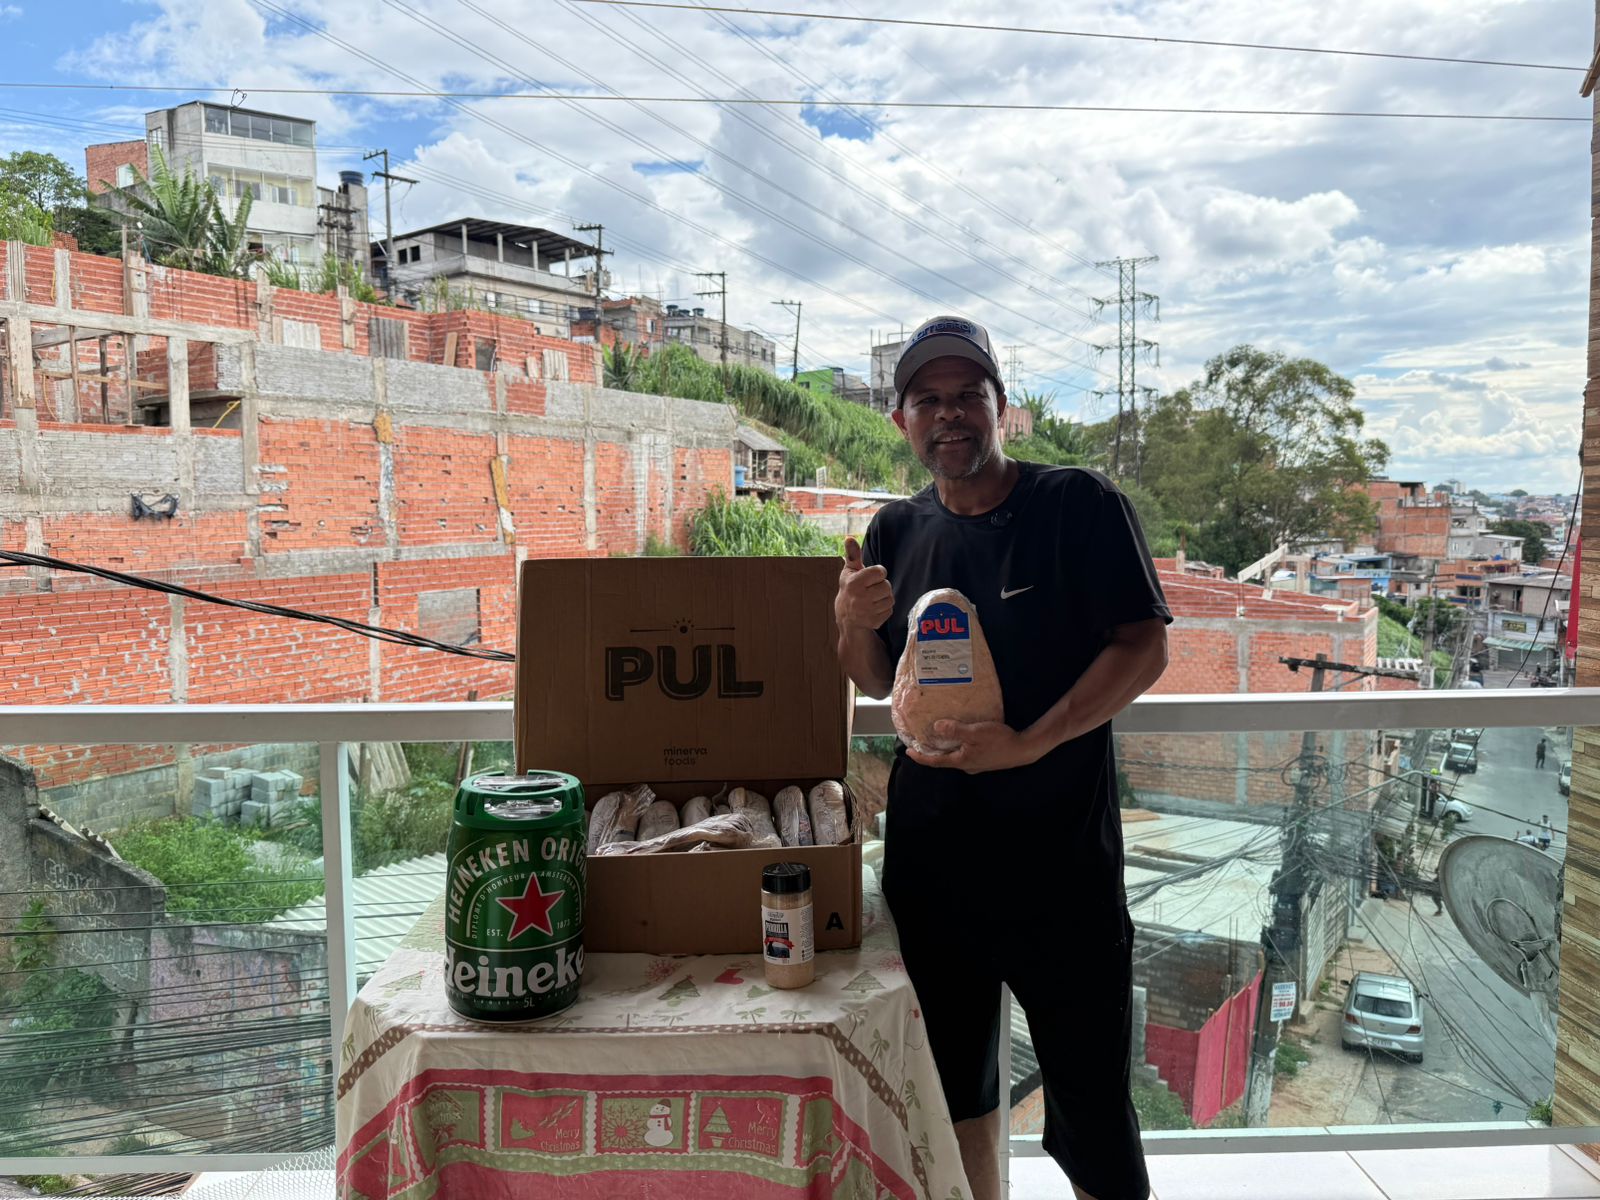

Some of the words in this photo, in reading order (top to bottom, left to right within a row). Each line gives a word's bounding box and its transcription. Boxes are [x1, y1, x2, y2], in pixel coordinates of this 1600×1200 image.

[921, 618, 965, 635] PUL
[604, 644, 764, 701] PUL
[663, 745, 708, 756] minerva
[663, 756, 696, 767] foods
[448, 838, 530, 924] HEINEKEN
[824, 911, 845, 931] A
[486, 928, 504, 937] EST.
[555, 1127, 580, 1139] Merry
[748, 1122, 778, 1141] Merry
[541, 1140, 580, 1152] Christmas
[727, 1136, 777, 1155] Christmas
